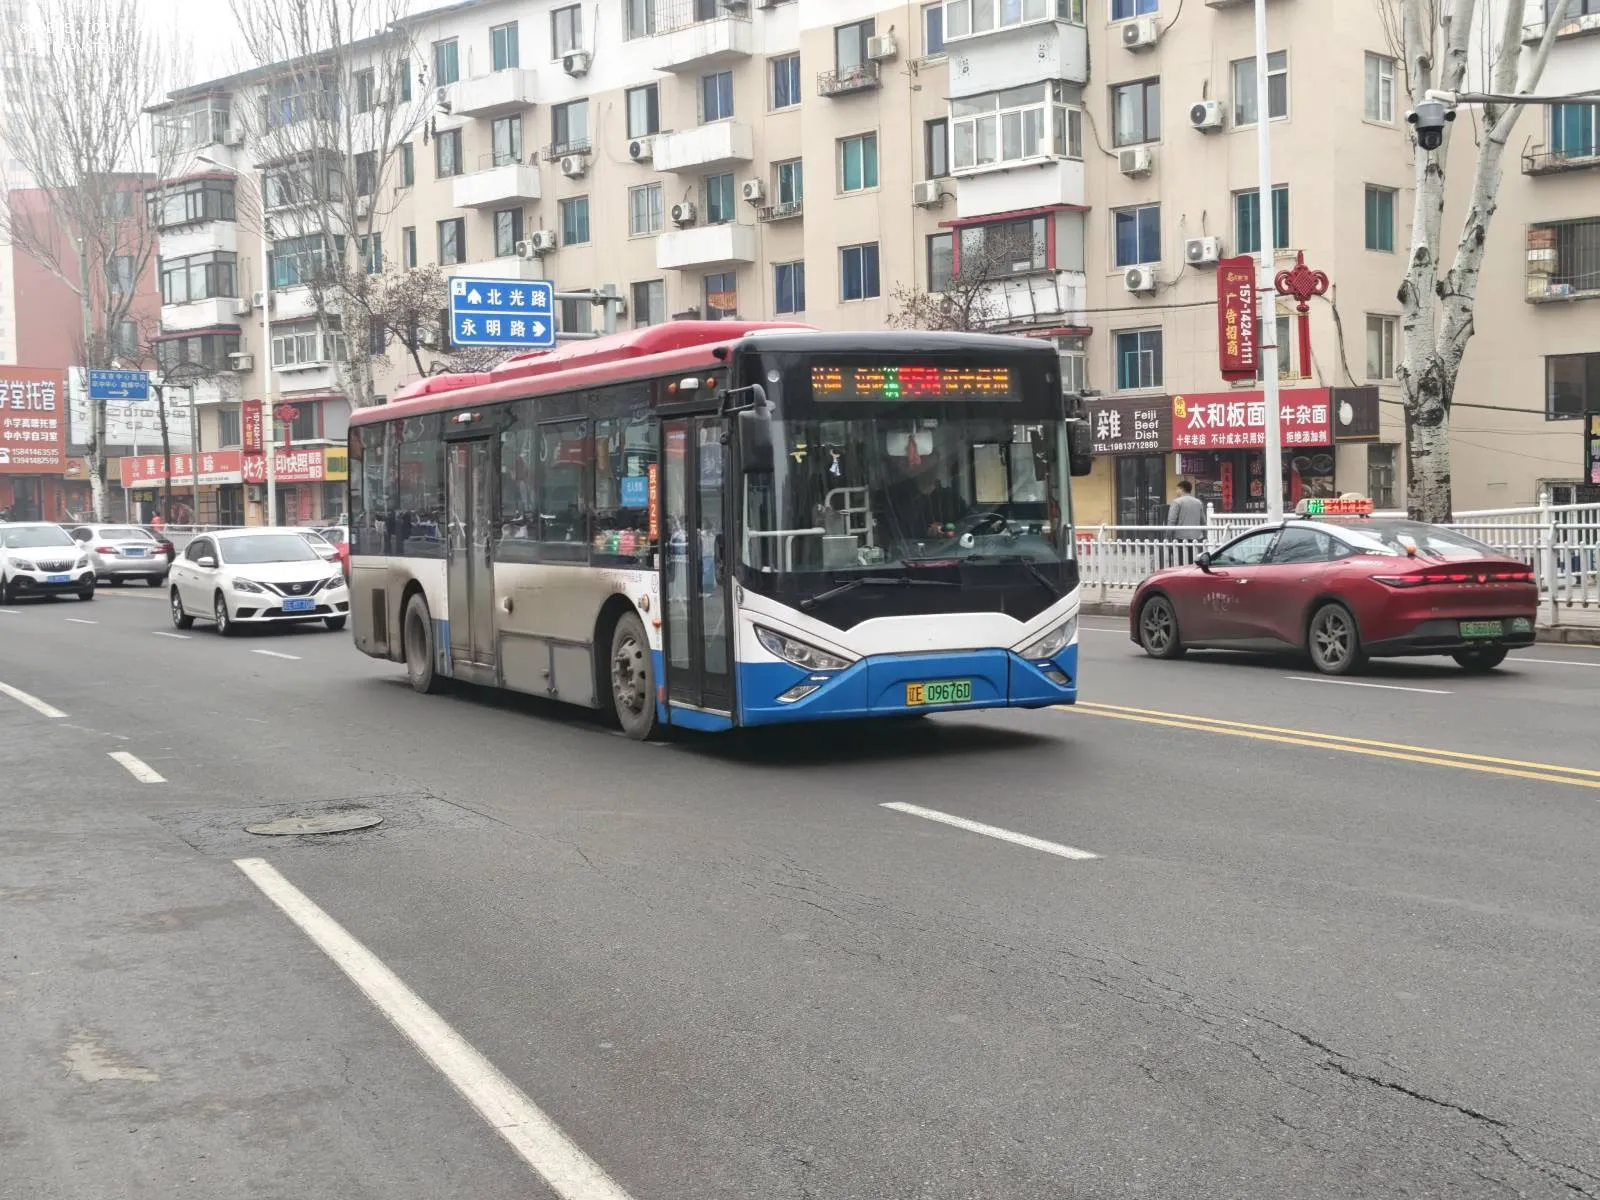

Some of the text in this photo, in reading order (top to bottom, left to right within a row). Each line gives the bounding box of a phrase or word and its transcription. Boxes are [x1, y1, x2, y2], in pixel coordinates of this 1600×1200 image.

[486, 288, 547, 308] 北光路
[461, 318, 526, 337] 永明路
[1240, 283, 1253, 364] 157-1424-1111
[1134, 410, 1157, 421] Feiji
[1187, 401, 1328, 429] 太和板面 牛杂面
[1134, 420, 1159, 430] Beef
[1135, 430, 1159, 440] Dish
[1176, 434, 1206, 446] 十年老店
[1286, 430, 1327, 443] 拒绝添加剂
